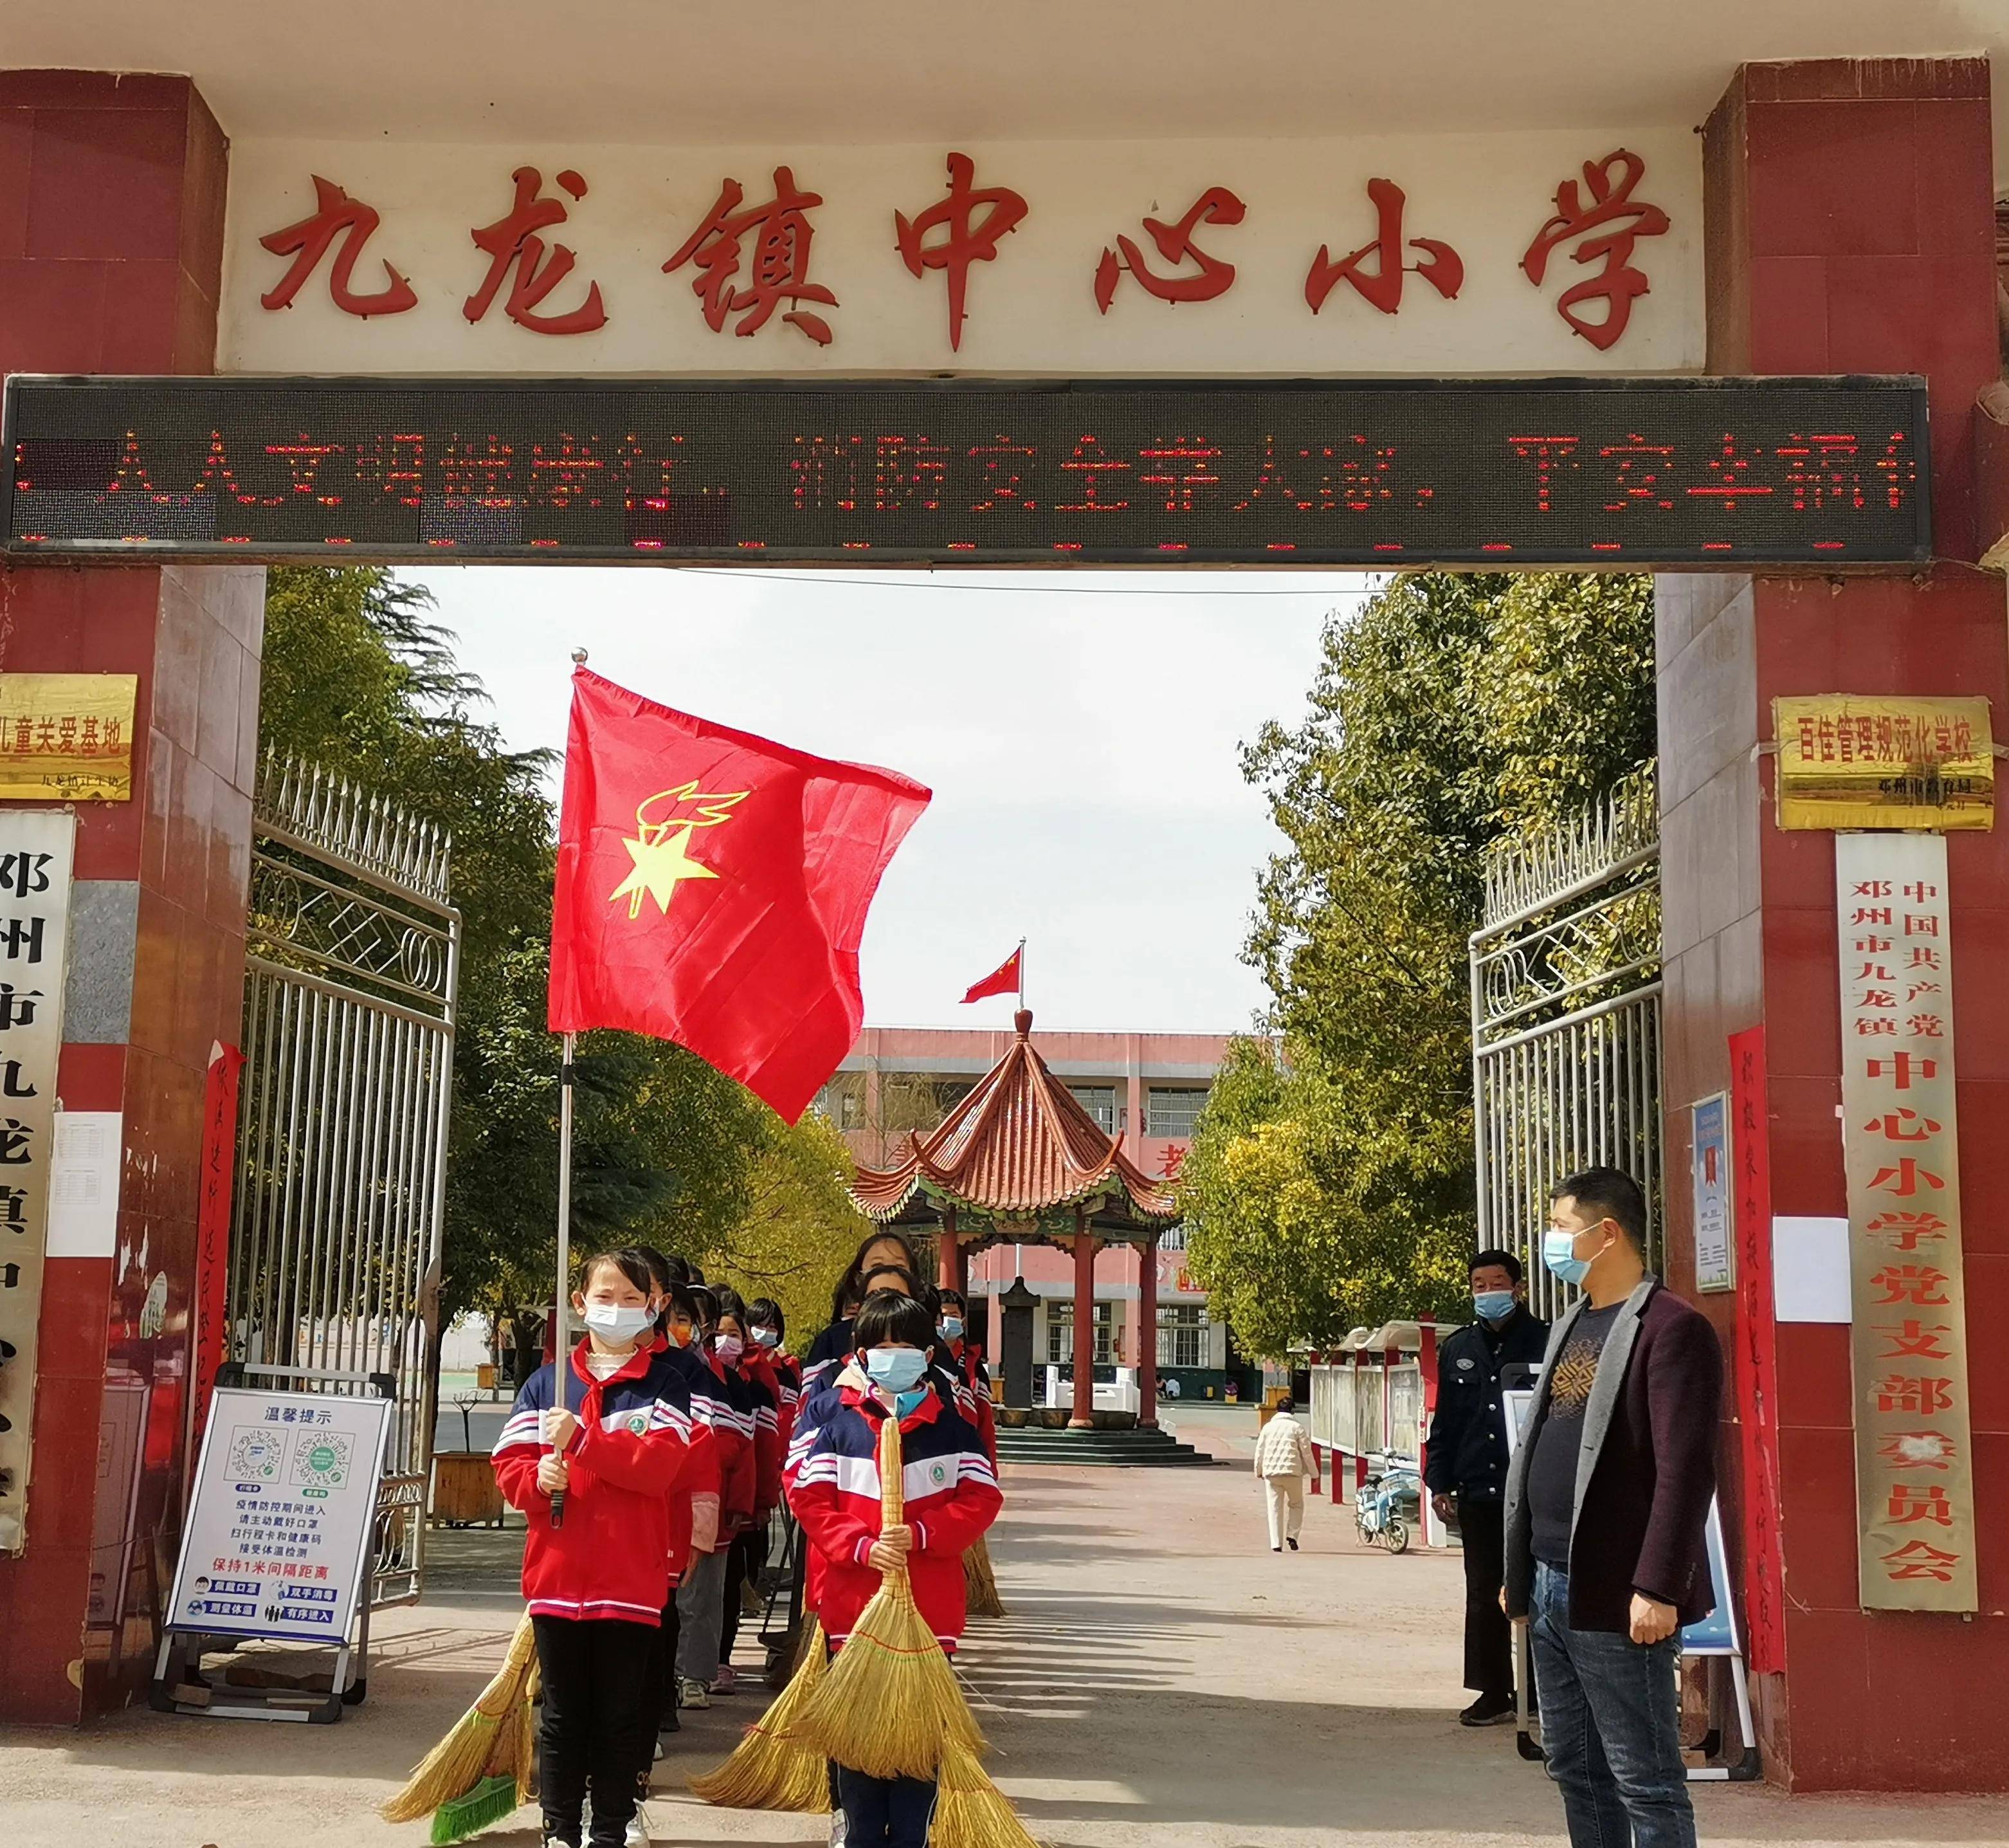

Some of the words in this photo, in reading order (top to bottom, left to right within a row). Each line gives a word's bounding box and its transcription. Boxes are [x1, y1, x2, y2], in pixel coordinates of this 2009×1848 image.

[259, 147, 1670, 352] 九龙镇中心小学
[1849, 880, 1898, 1037] 邓州市九龙镇
[1903, 881, 1944, 1038] 中国共产党
[1864, 1052, 1961, 1582] 中心小学党支部委员会
[264, 1406, 332, 1425] 温馨提示
[235, 1499, 326, 1515] 疫情防控期间进入
[239, 1514, 318, 1529] 请主动戴好口罩
[230, 1528, 322, 1545] 扫行程卡和健康码
[239, 1543, 308, 1559] 接受体温检测
[212, 1557, 329, 1580] 保持1米间隔距离
